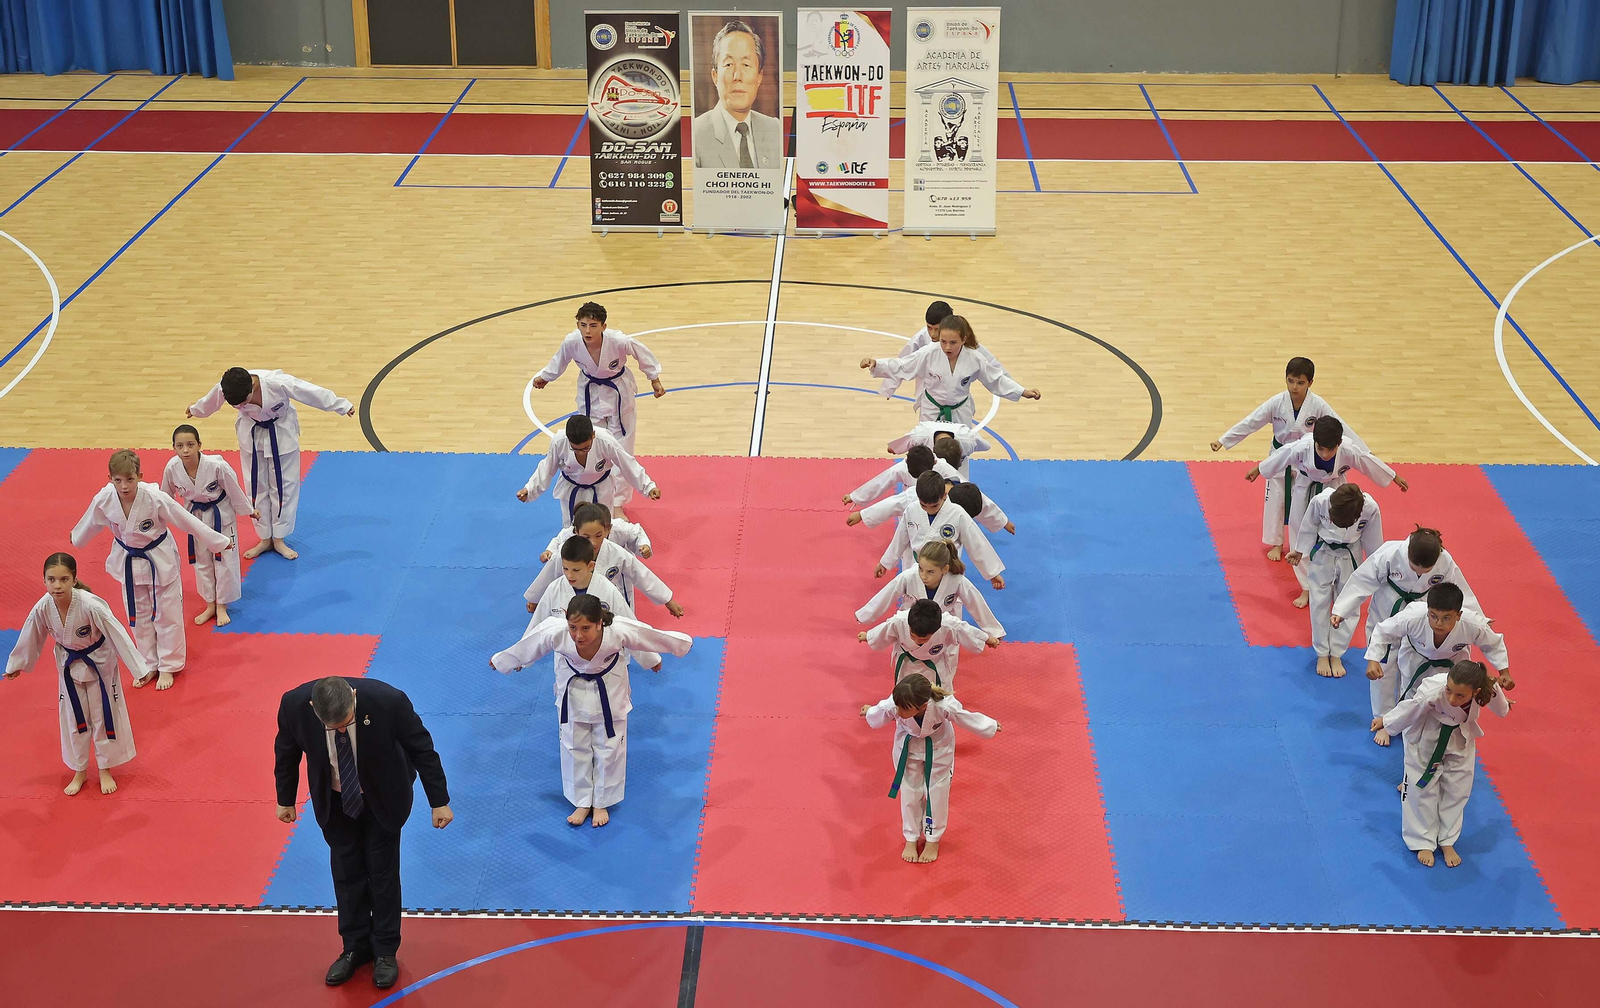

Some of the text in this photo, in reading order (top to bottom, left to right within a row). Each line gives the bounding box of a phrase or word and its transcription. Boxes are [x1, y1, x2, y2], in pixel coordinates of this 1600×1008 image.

[926, 51, 980, 60] ACADEMIA DE
[917, 62, 990, 70] ARTES MARCIALES
[804, 65, 884, 81] TAEKWON-DO
[846, 84, 882, 115] ITF
[821, 115, 868, 138] España
[601, 142, 672, 153] DO-SAN
